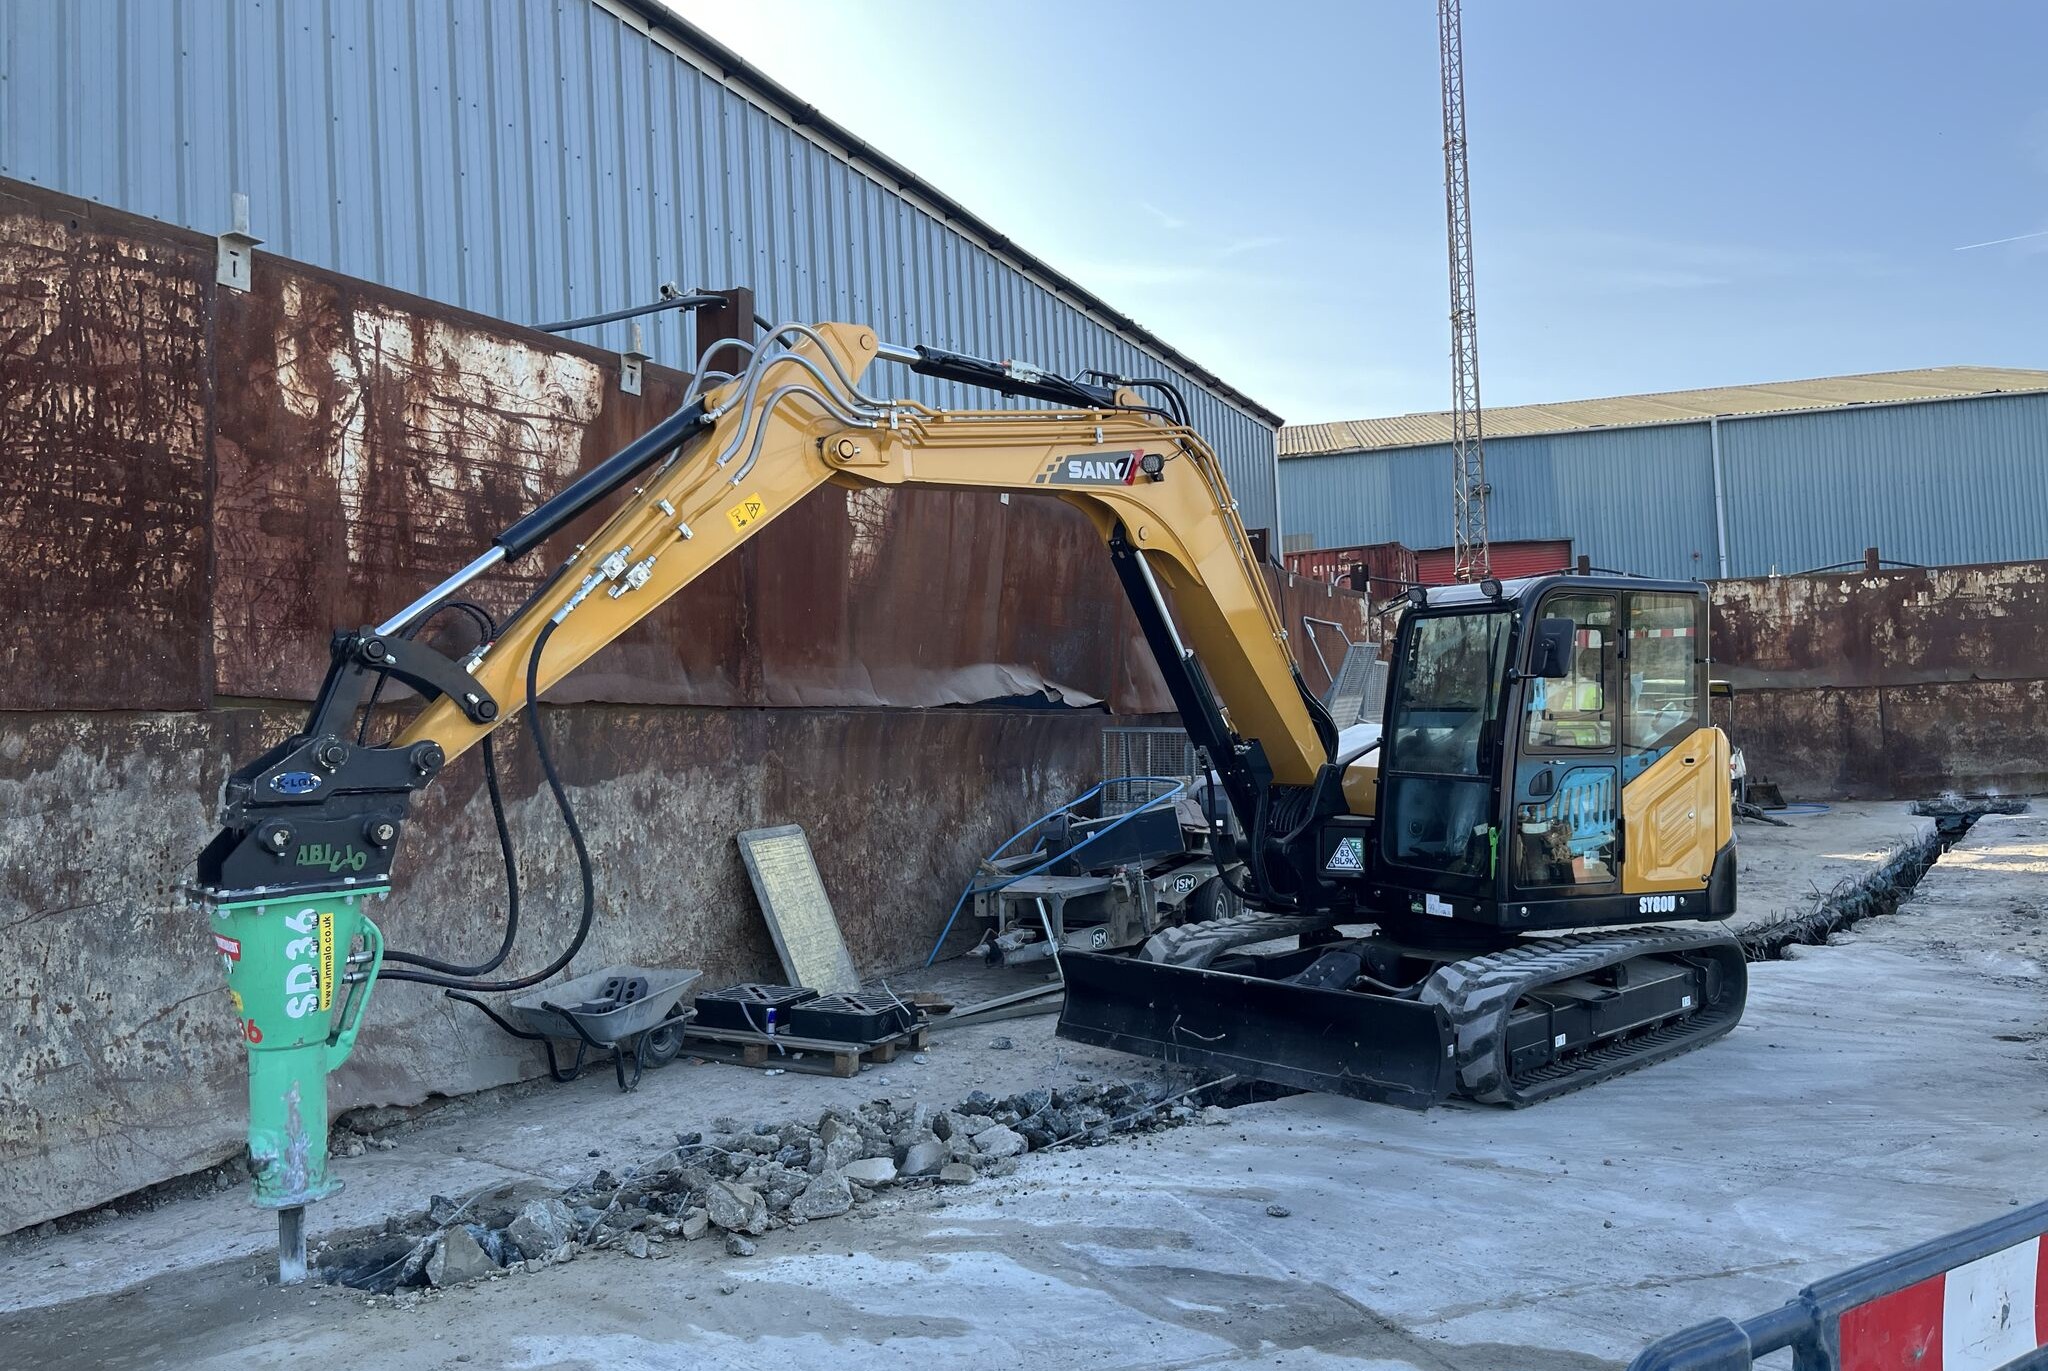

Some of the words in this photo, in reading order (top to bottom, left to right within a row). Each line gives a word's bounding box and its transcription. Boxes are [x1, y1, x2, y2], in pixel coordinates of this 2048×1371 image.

[1068, 460, 1123, 480] SANY
[1639, 895, 1676, 913] SY80U
[286, 908, 320, 1019] SD36
[323, 915, 332, 1009] www.inmalo.co.uk
